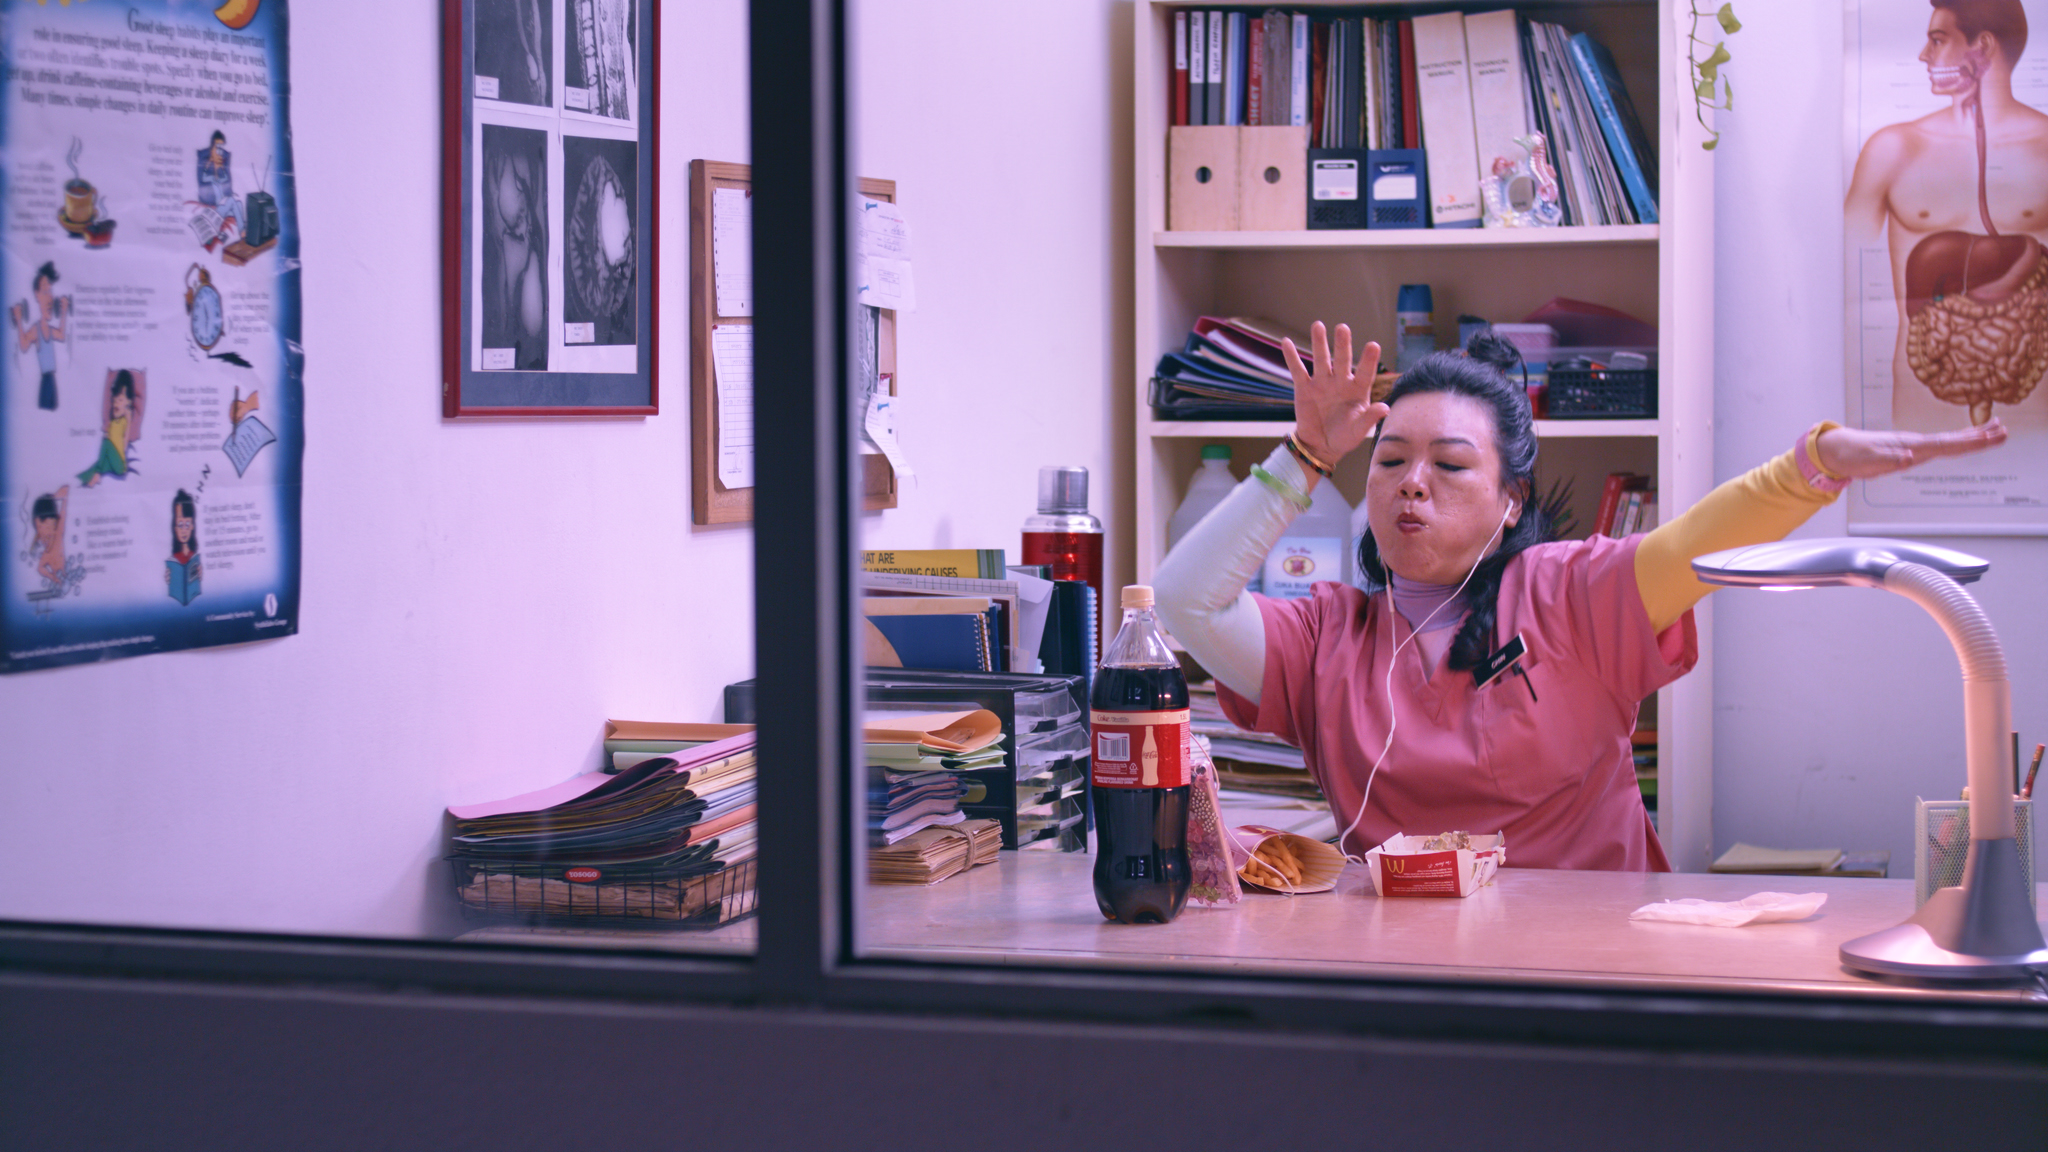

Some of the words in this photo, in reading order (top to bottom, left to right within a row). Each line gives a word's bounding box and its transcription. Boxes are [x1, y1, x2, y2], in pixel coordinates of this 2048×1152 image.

[128, 7, 153, 33] Good
[1444, 202, 1476, 211] HITACHI
[860, 553, 875, 565] HAT
[877, 553, 895, 565] ARE
[924, 567, 958, 578] CAUSES
